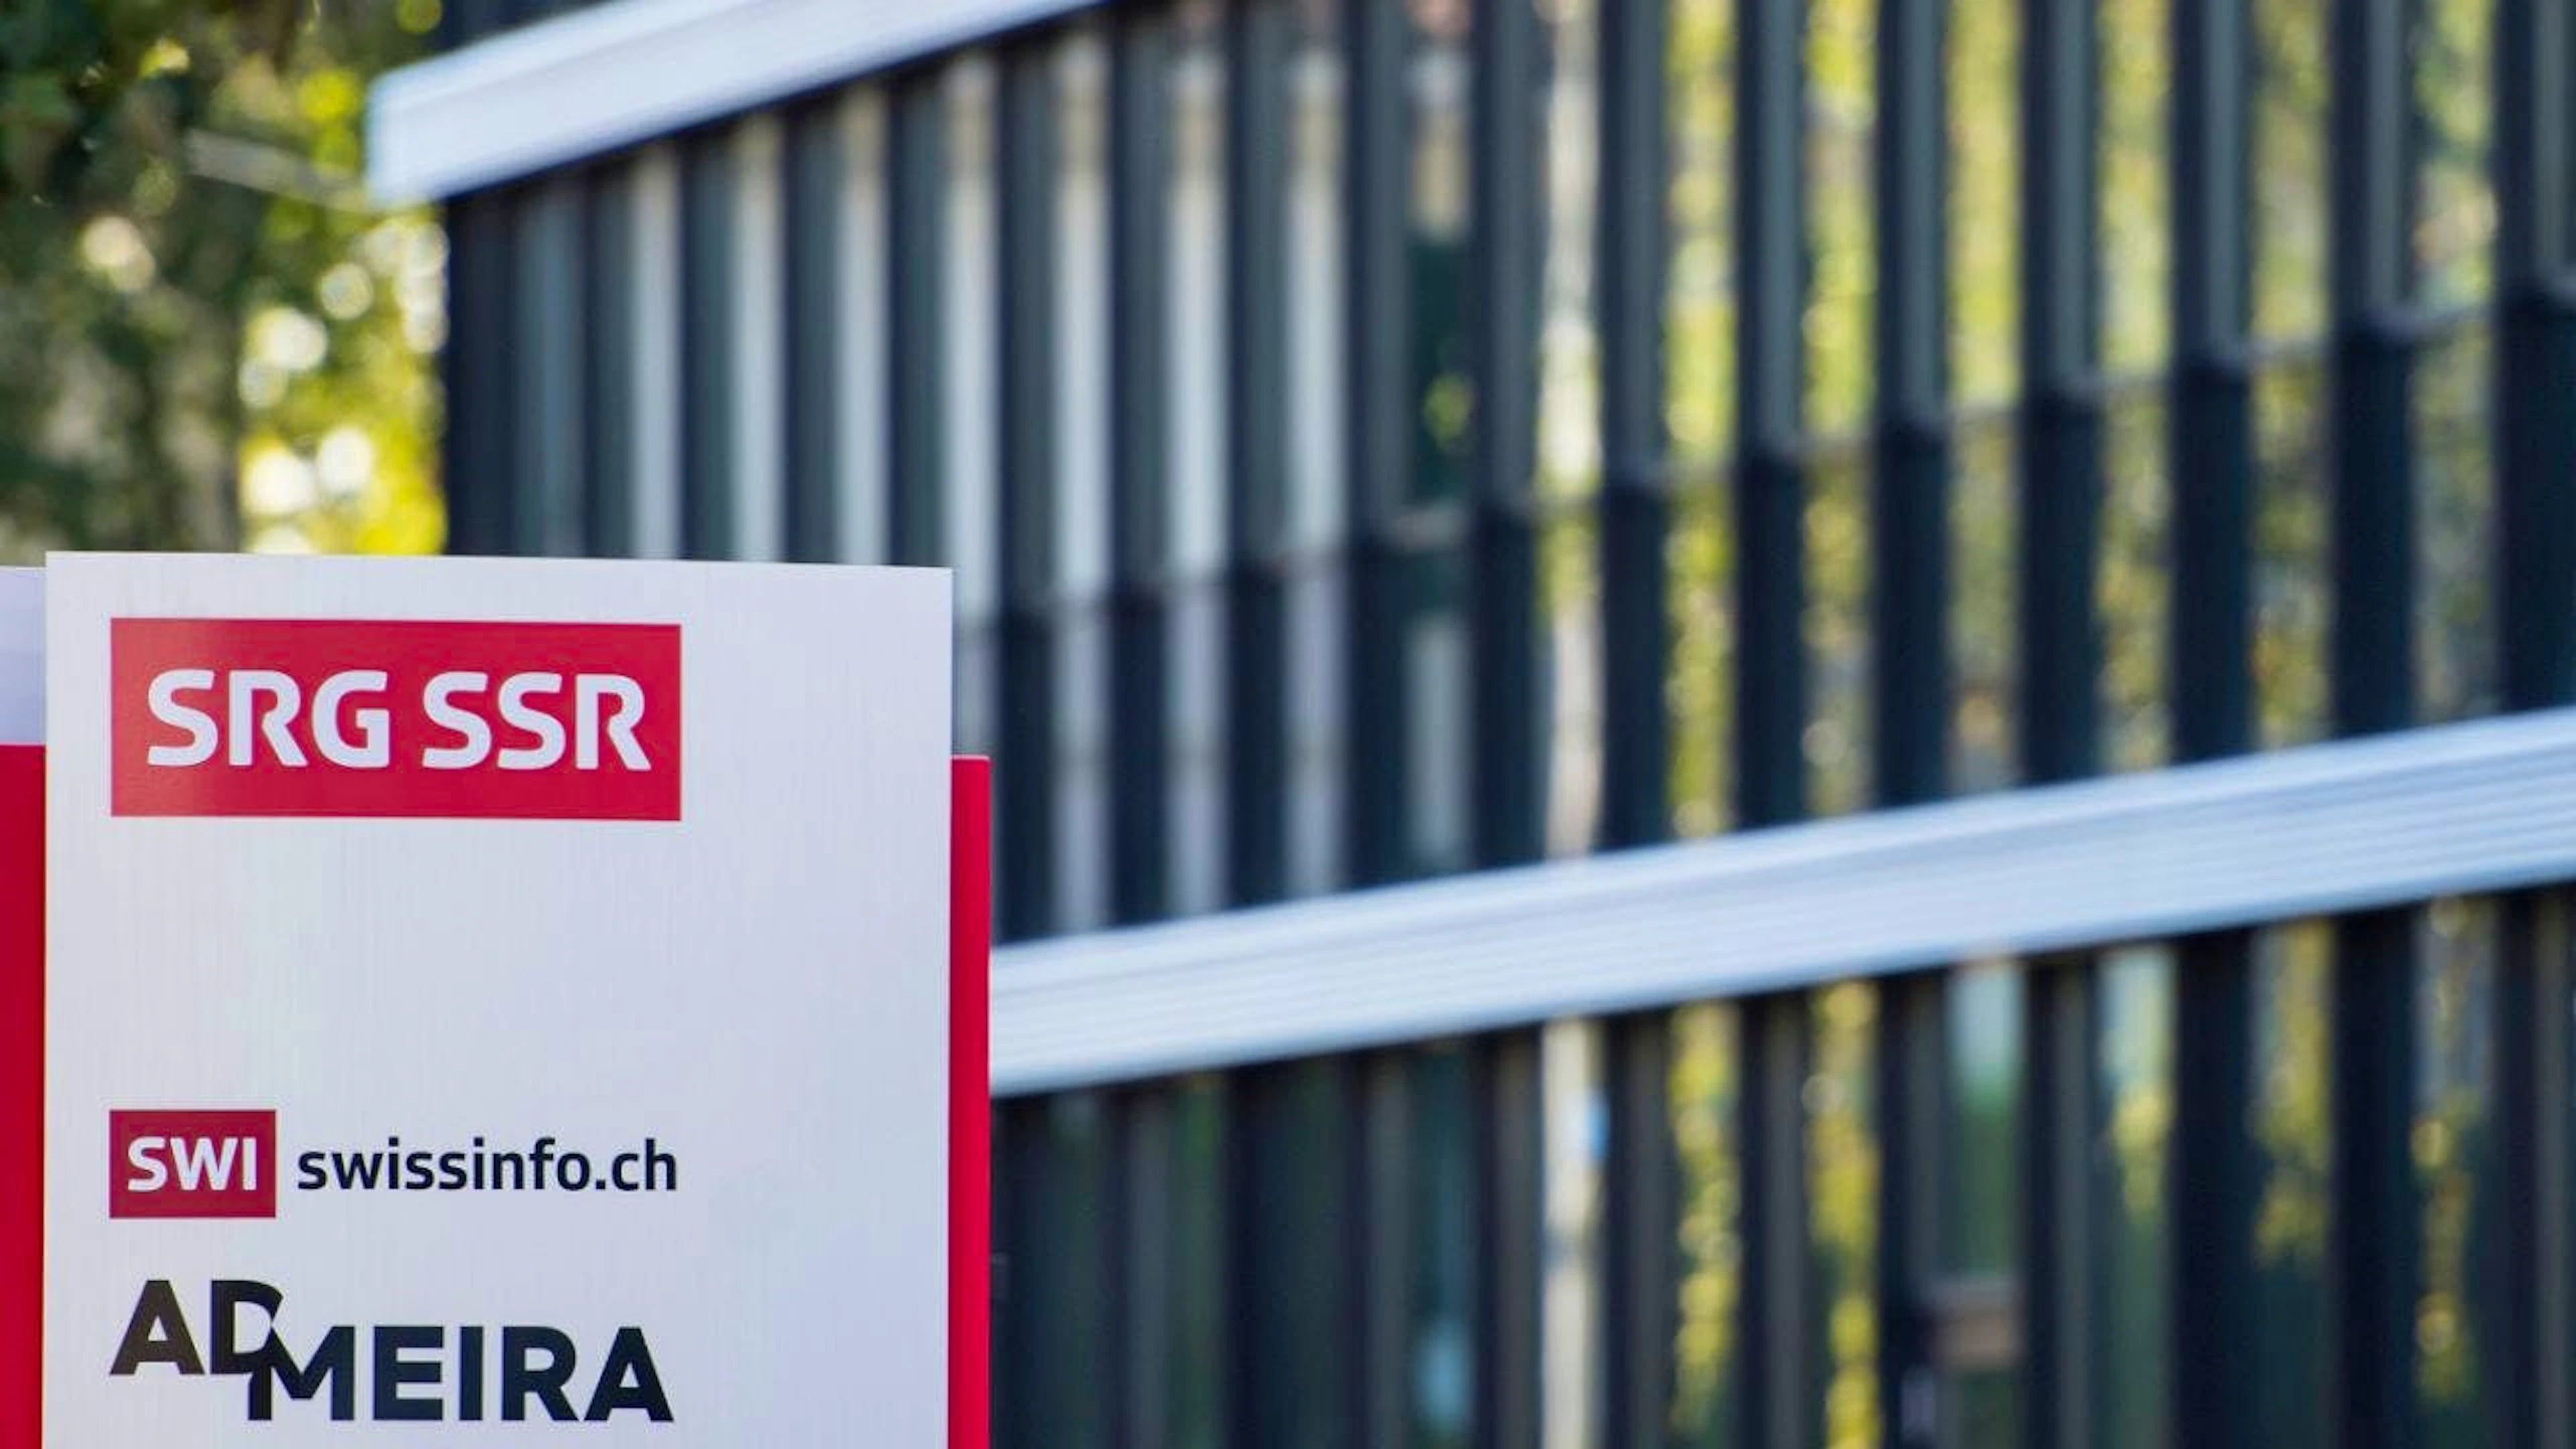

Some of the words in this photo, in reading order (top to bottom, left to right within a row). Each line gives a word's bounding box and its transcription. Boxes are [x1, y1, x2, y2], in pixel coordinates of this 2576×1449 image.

[147, 669, 389, 769] SRG
[422, 672, 651, 771] SSR
[127, 1136, 256, 1191] SWI
[297, 1136, 677, 1191] swissinfo.ch
